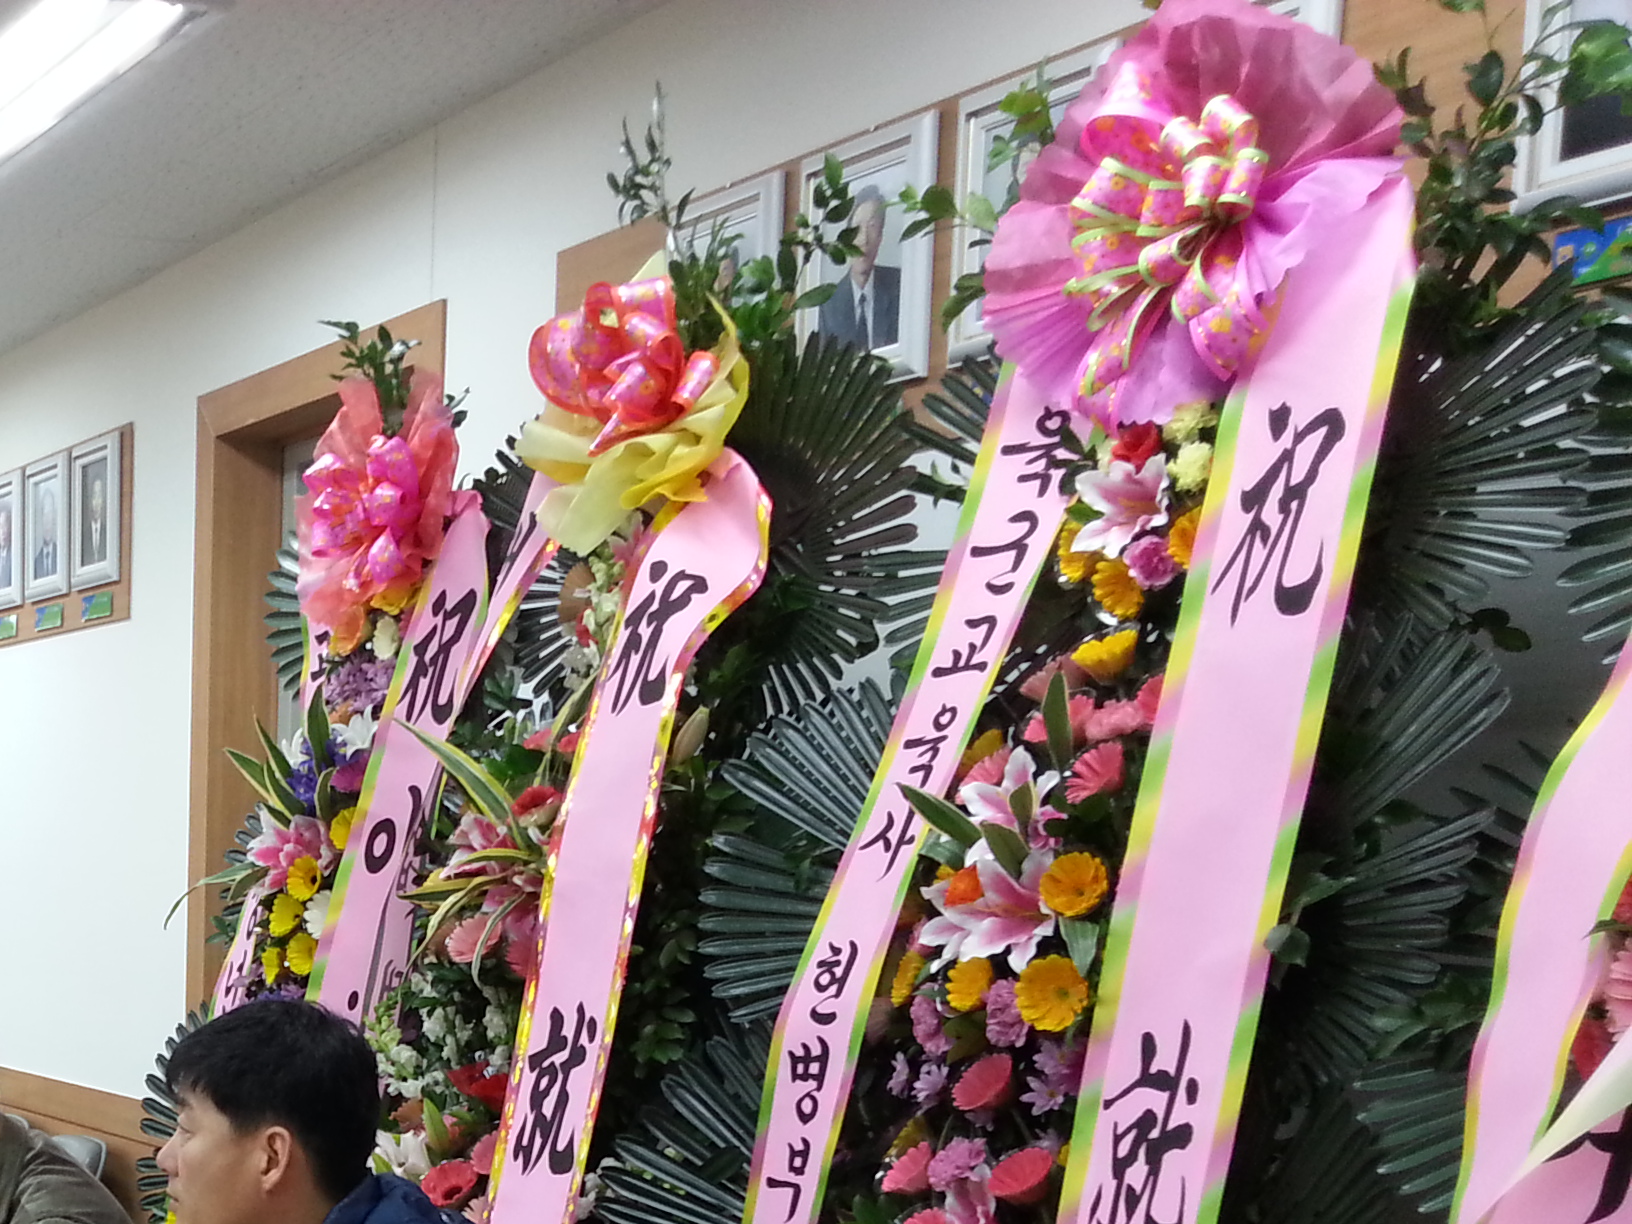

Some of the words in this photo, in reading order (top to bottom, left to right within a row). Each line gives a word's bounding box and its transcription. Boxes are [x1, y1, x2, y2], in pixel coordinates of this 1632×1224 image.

[1211, 401, 1348, 628] 祝
[395, 587, 479, 726] 祝
[609, 559, 709, 717] 祝
